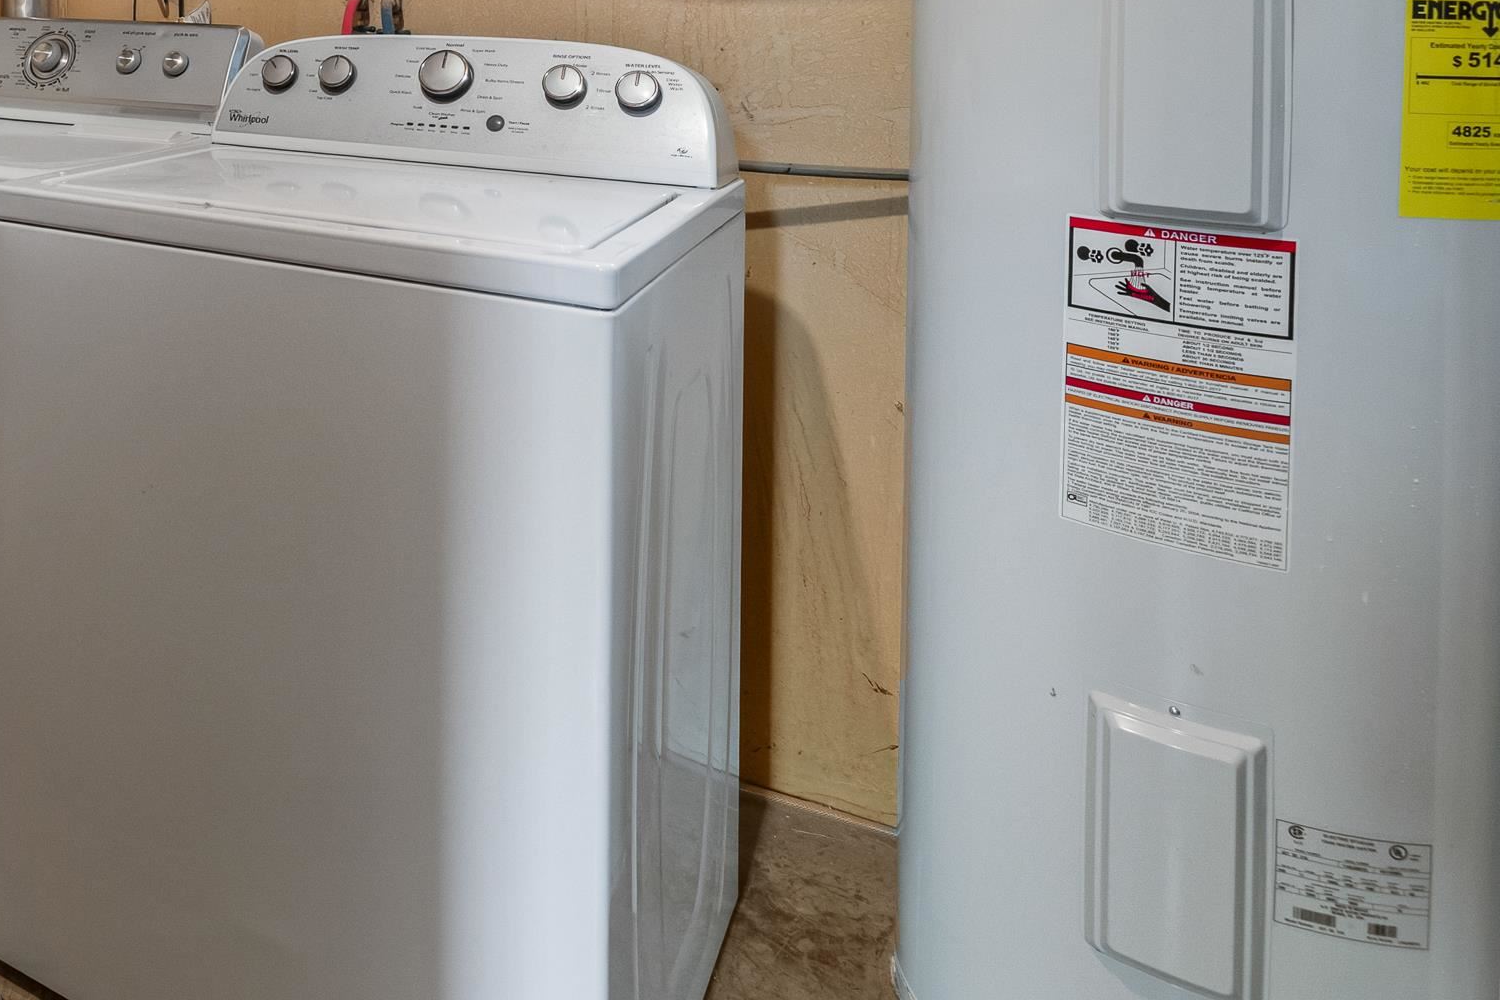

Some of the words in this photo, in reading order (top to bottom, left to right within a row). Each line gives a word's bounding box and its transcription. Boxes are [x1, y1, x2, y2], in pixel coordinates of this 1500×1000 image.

[229, 113, 269, 124] Whirlpool
[1452, 126, 1491, 138] 4825
[1161, 230, 1217, 244] DANGER
[1131, 358, 1169, 371] WARNING
[1176, 365, 1236, 382] ADVERTENCIA
[1153, 396, 1194, 411] DANGER
[1153, 414, 1193, 428] WARNING
